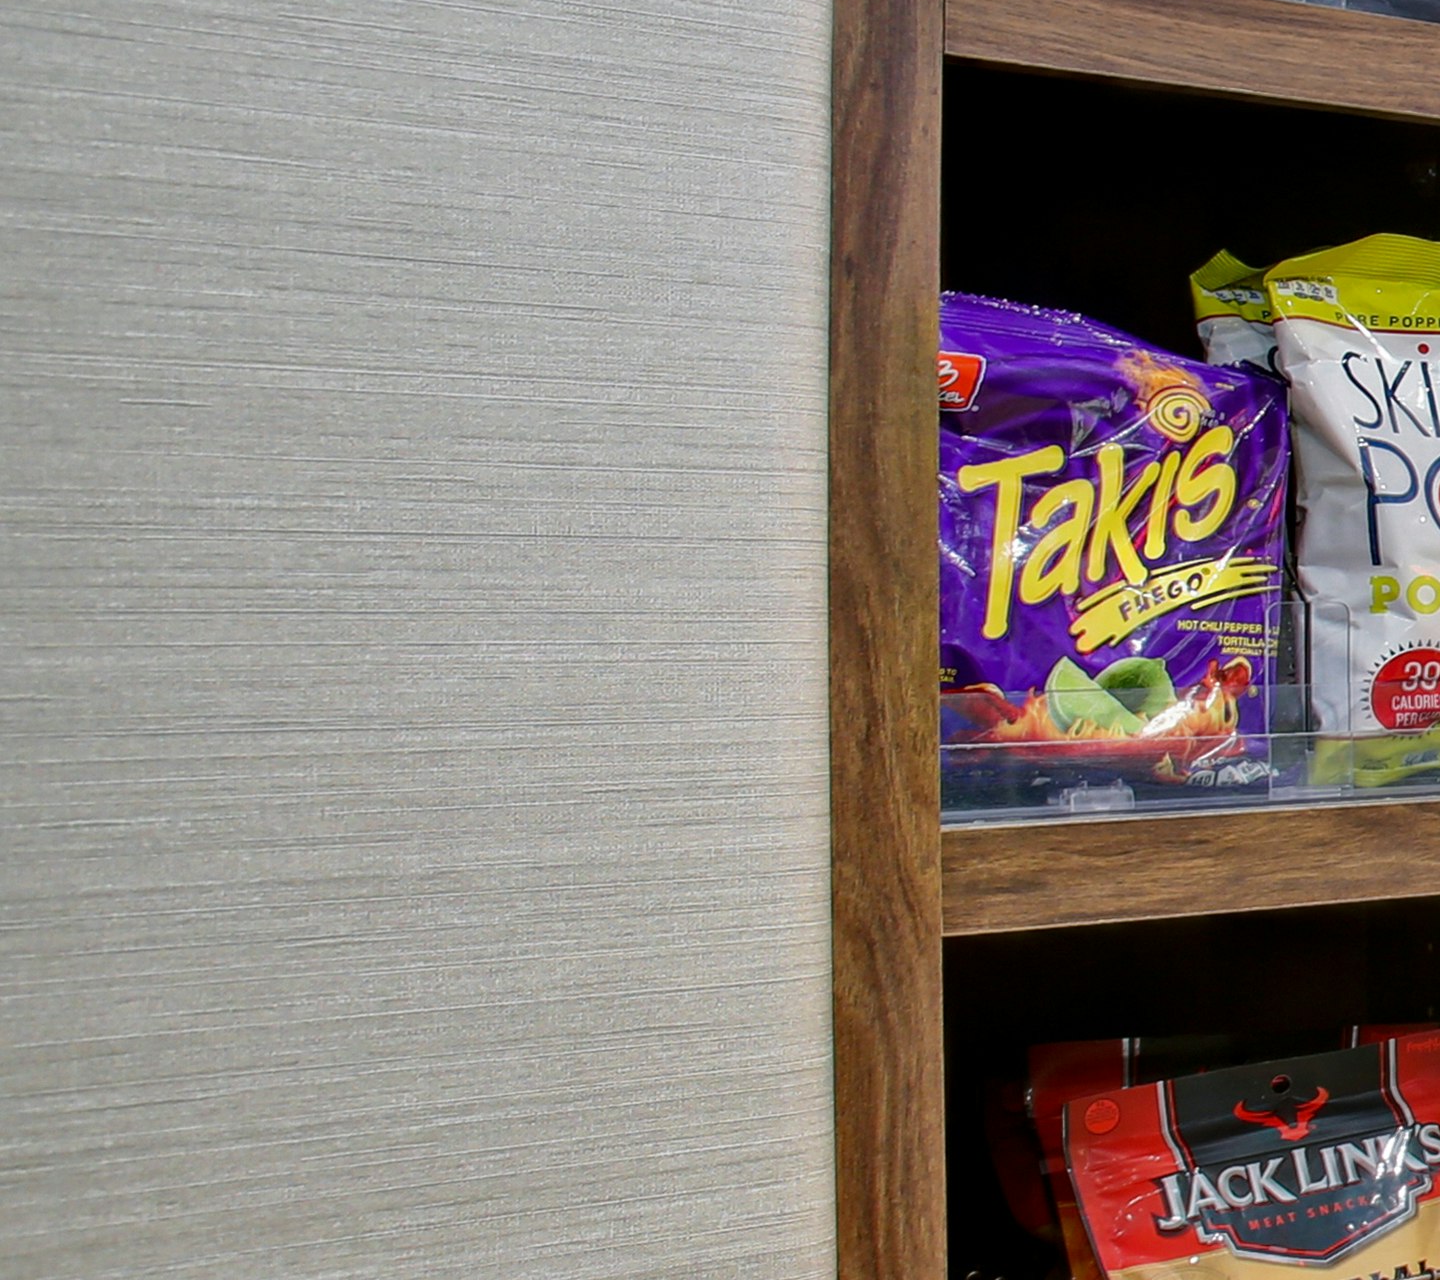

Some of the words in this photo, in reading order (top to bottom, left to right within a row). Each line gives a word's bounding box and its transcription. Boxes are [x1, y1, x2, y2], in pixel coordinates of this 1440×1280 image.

[1117, 572, 1204, 623] FUEGO
[1177, 619, 1199, 631] HOT
[1200, 620, 1222, 632] CHILI
[1223, 622, 1263, 634] PEPPER
[1402, 661, 1440, 692] 39
[1395, 711, 1418, 728] PER
[1157, 1158, 1297, 1231] JACK
[1248, 1211, 1297, 1231] MEAT
